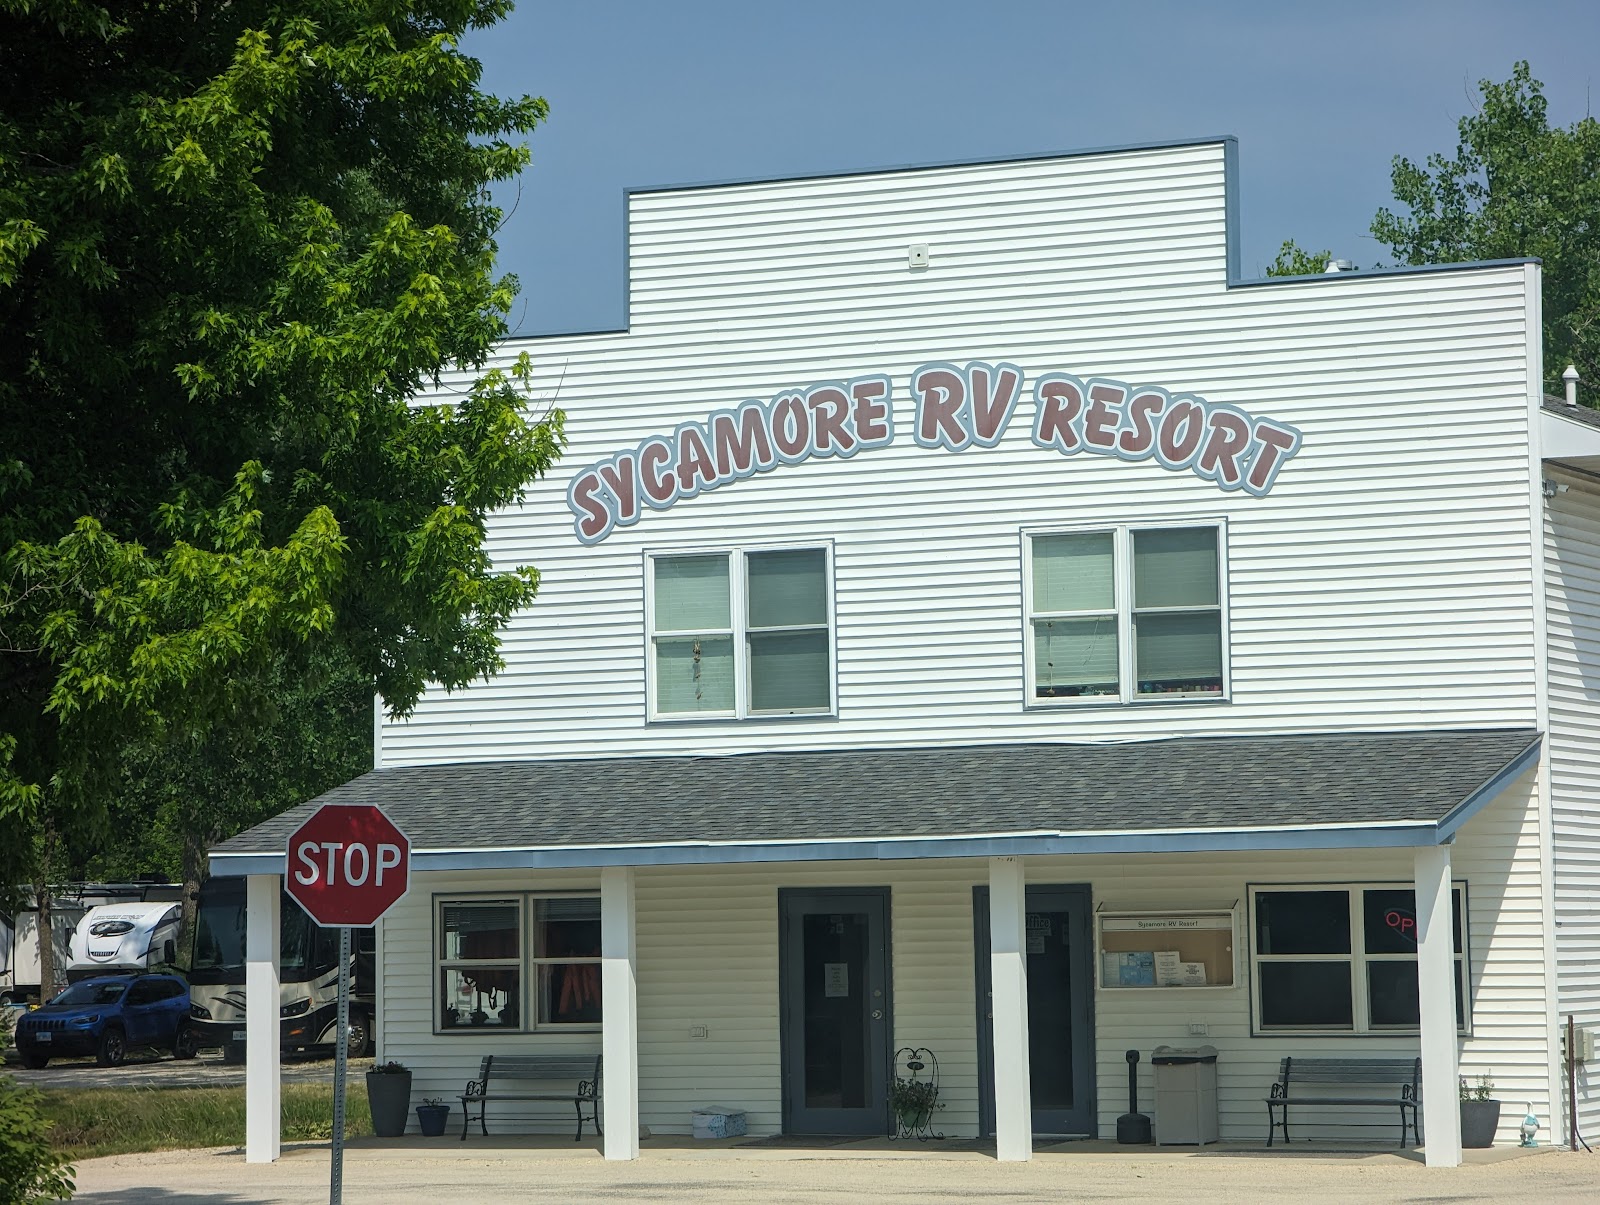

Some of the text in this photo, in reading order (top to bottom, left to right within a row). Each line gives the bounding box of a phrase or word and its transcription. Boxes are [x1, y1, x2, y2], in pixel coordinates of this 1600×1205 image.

[570, 364, 1299, 542] SYCAMORE RV RESORT
[294, 841, 402, 887] STOP
[1026, 914, 1050, 928] ffice
[1386, 912, 1417, 938] OP
